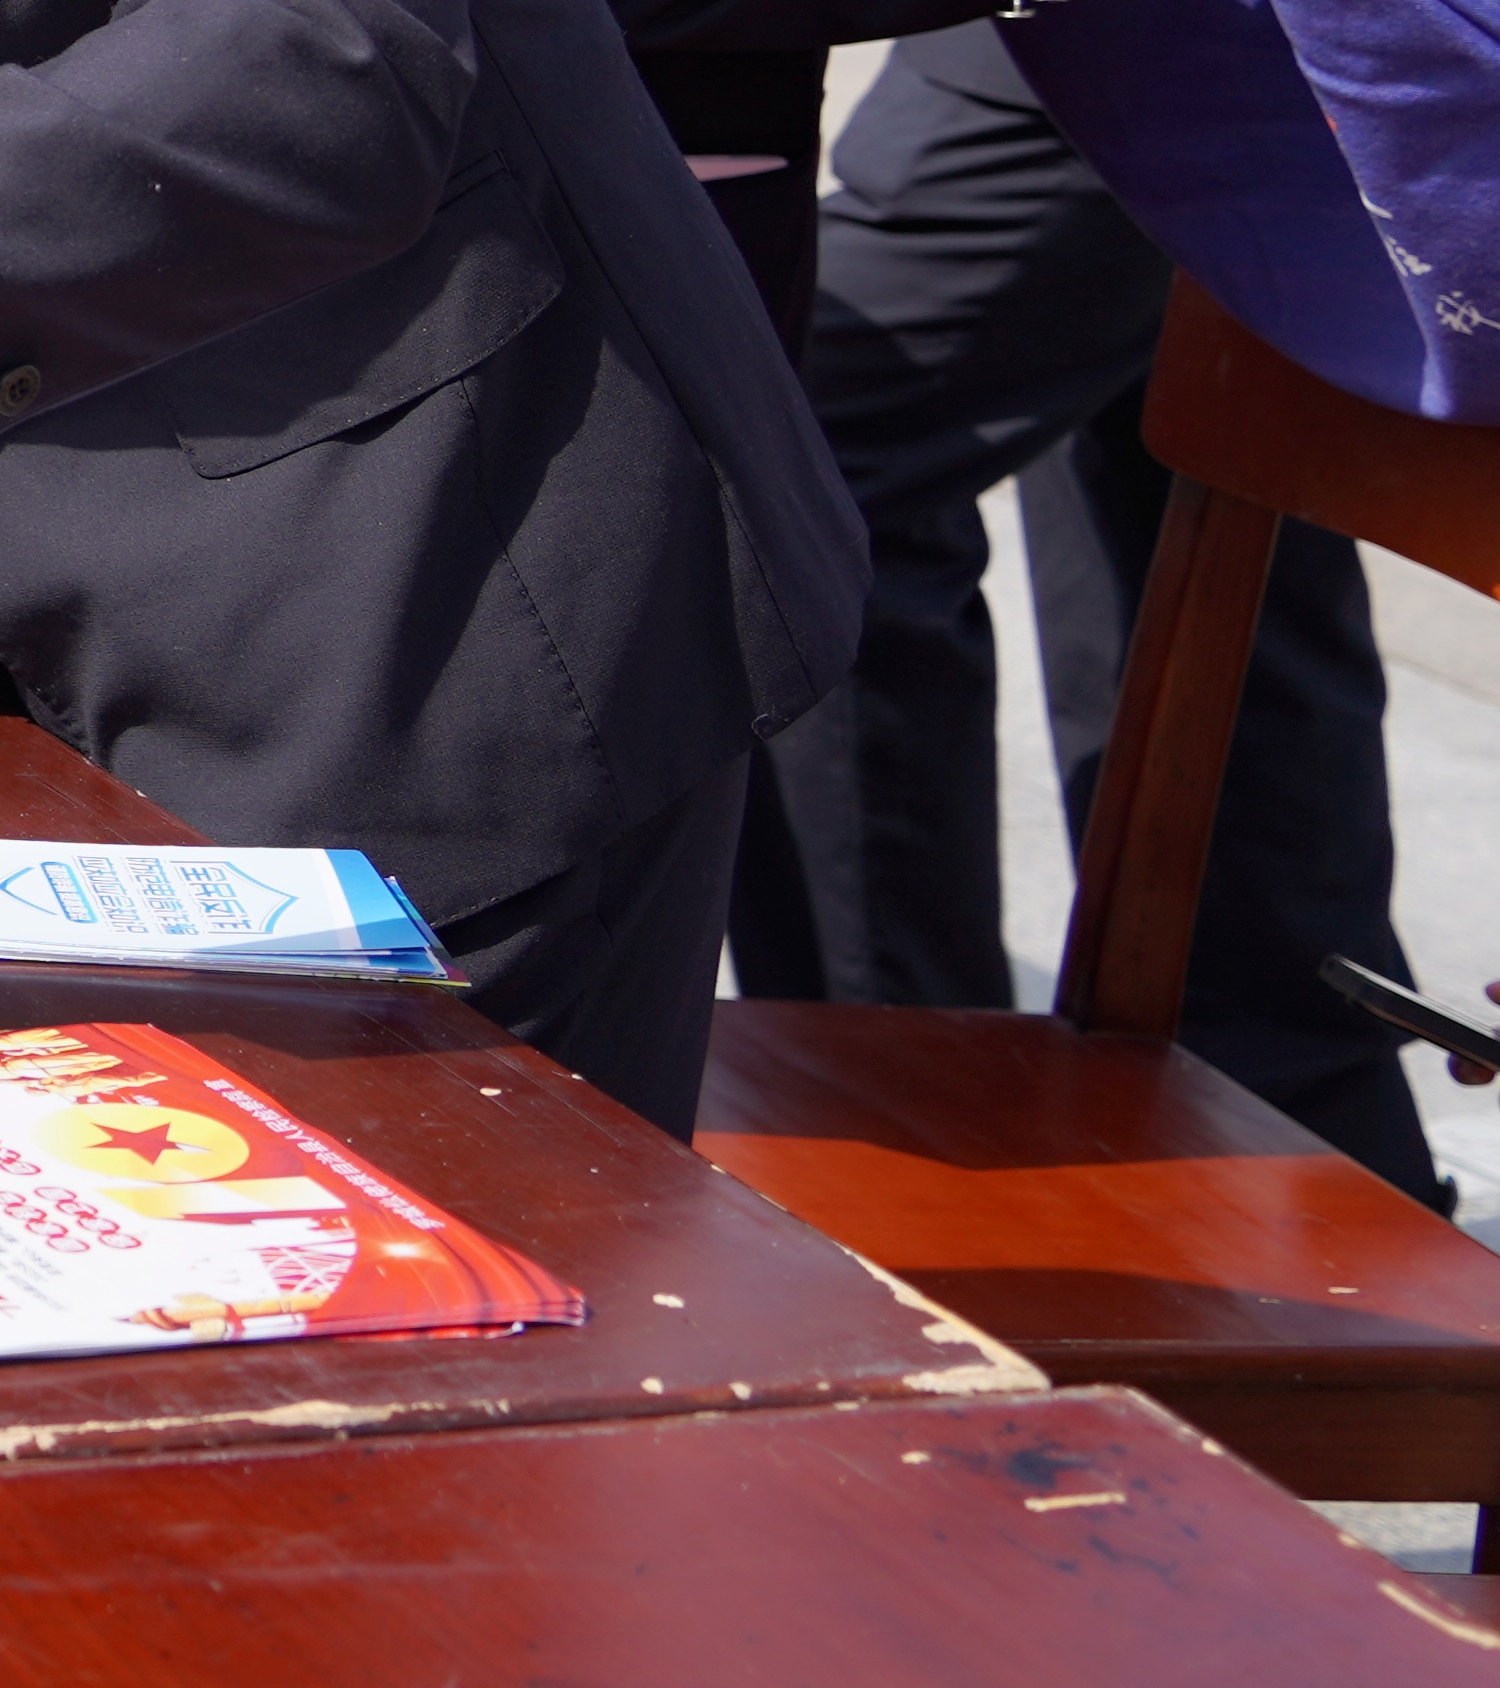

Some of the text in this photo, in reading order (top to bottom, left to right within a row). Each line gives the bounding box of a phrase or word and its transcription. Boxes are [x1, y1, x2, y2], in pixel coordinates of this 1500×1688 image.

[69, 855, 155, 933] 应知应会知识
[118, 856, 207, 935] 防范电信诈骗
[174, 866, 261, 929] 全民反诈
